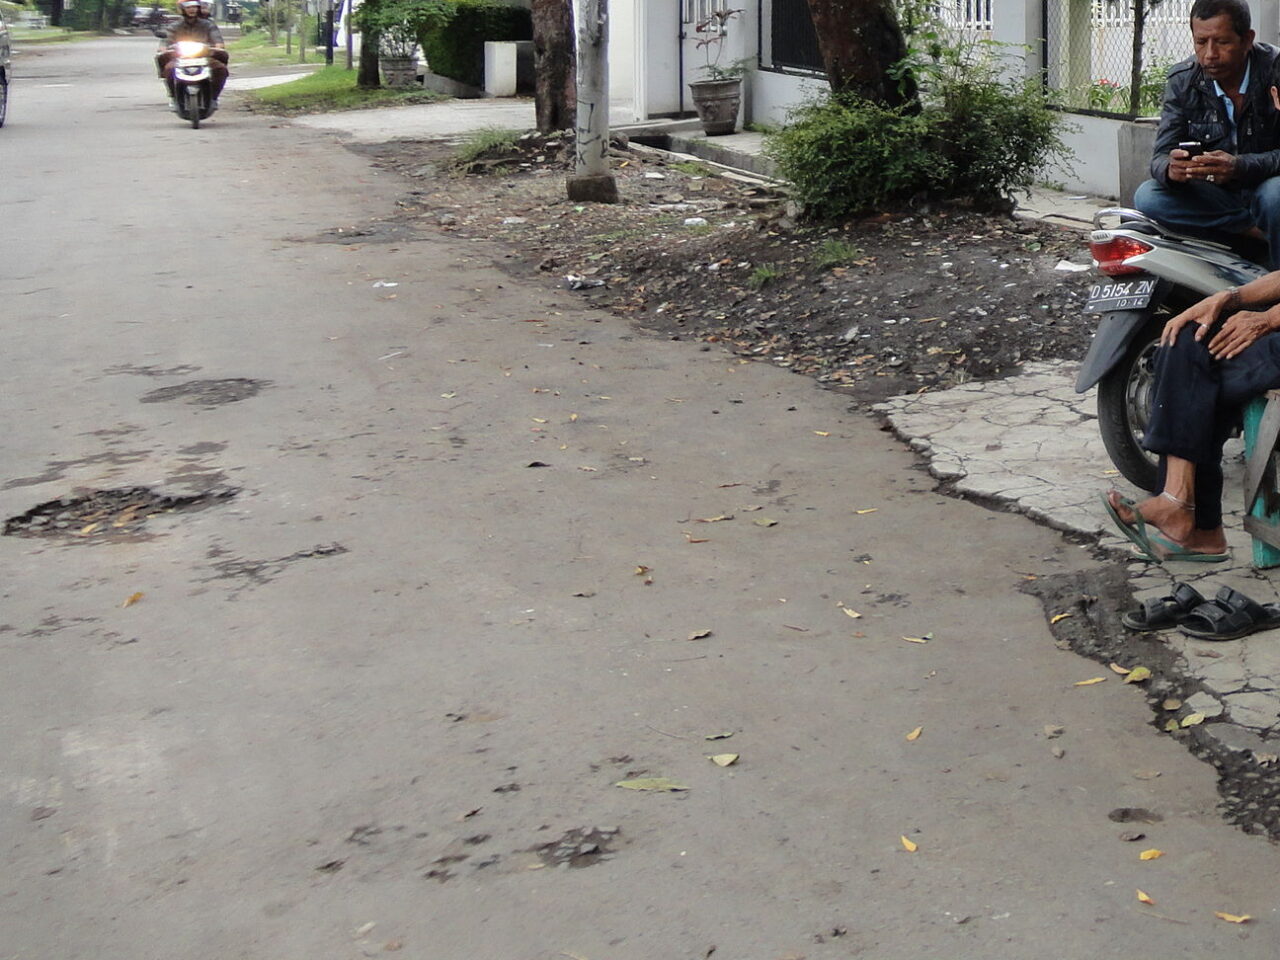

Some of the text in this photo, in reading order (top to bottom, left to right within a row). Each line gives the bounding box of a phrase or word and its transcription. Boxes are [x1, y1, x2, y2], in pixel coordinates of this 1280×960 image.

[1091, 280, 1154, 298] D 5154 ZN
